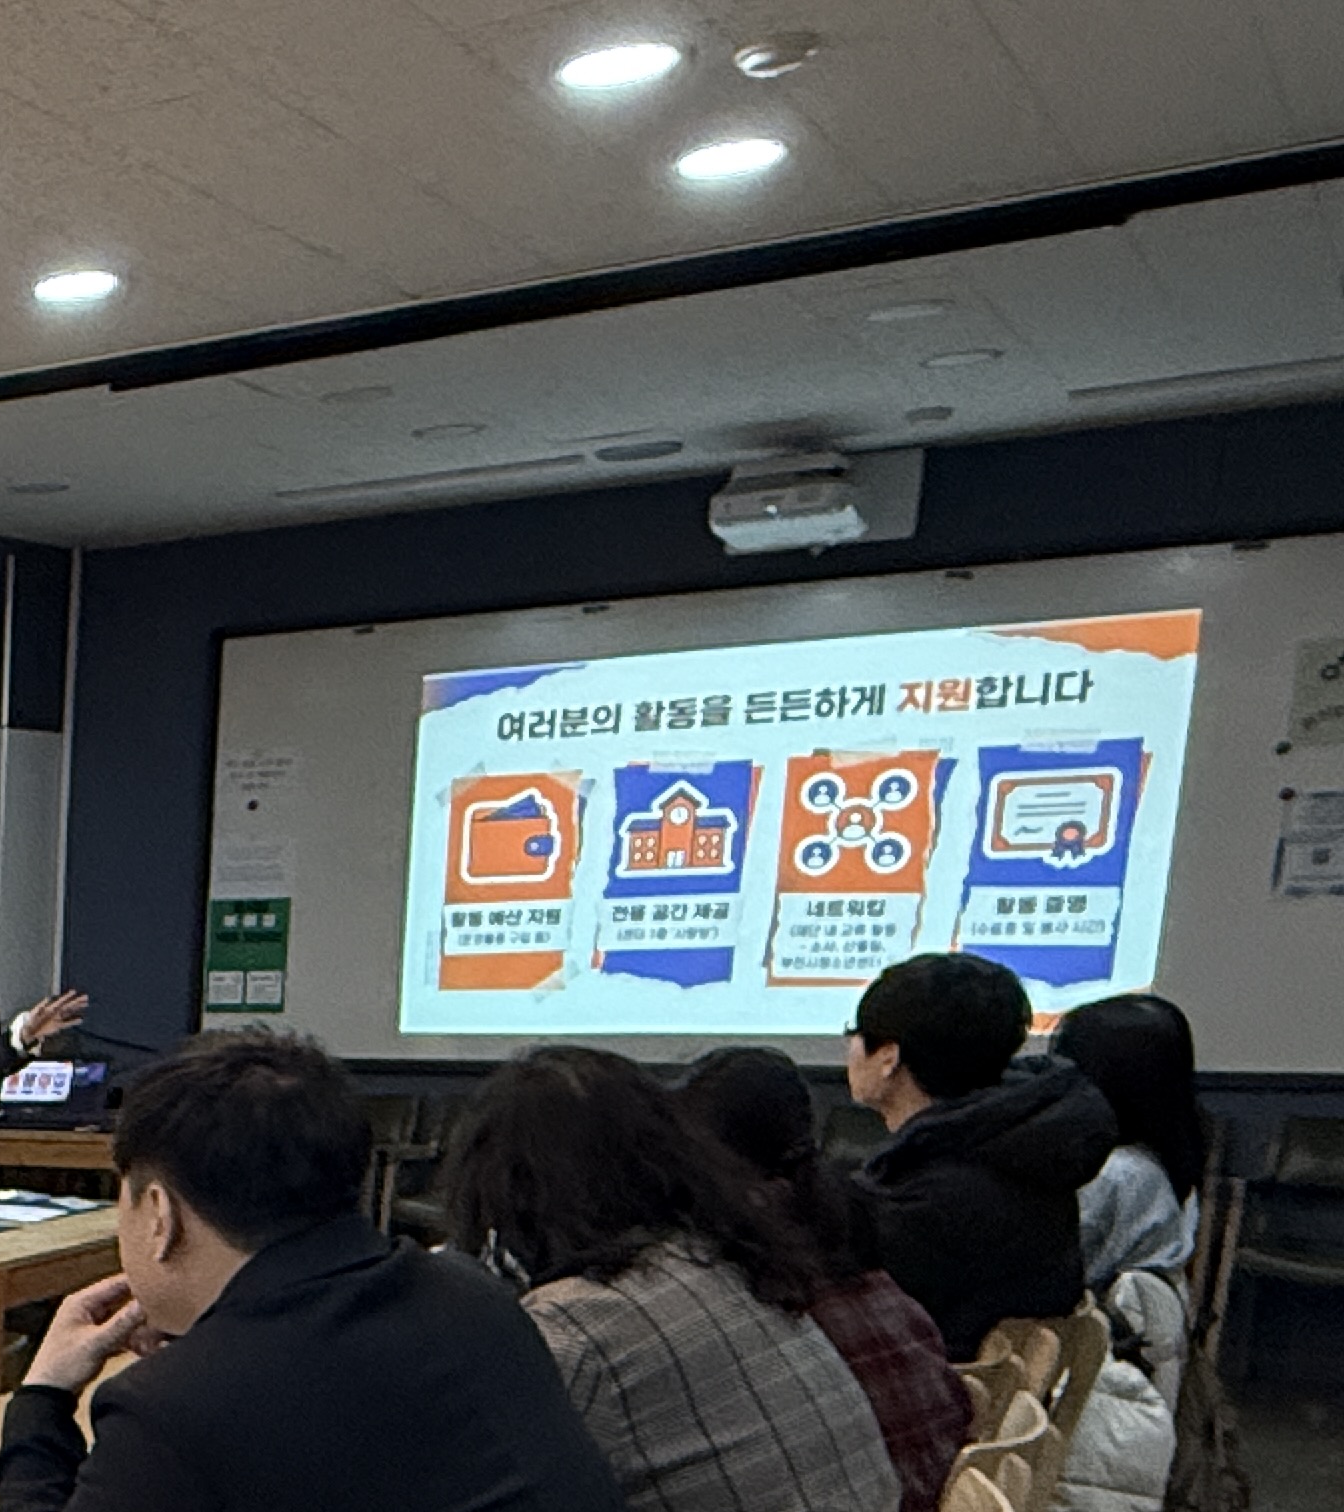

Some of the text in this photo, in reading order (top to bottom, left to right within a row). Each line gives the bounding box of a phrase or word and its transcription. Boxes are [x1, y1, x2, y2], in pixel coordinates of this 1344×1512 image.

[497, 669, 1096, 743] 여러분의 활동을 든든하게 지원합니다
